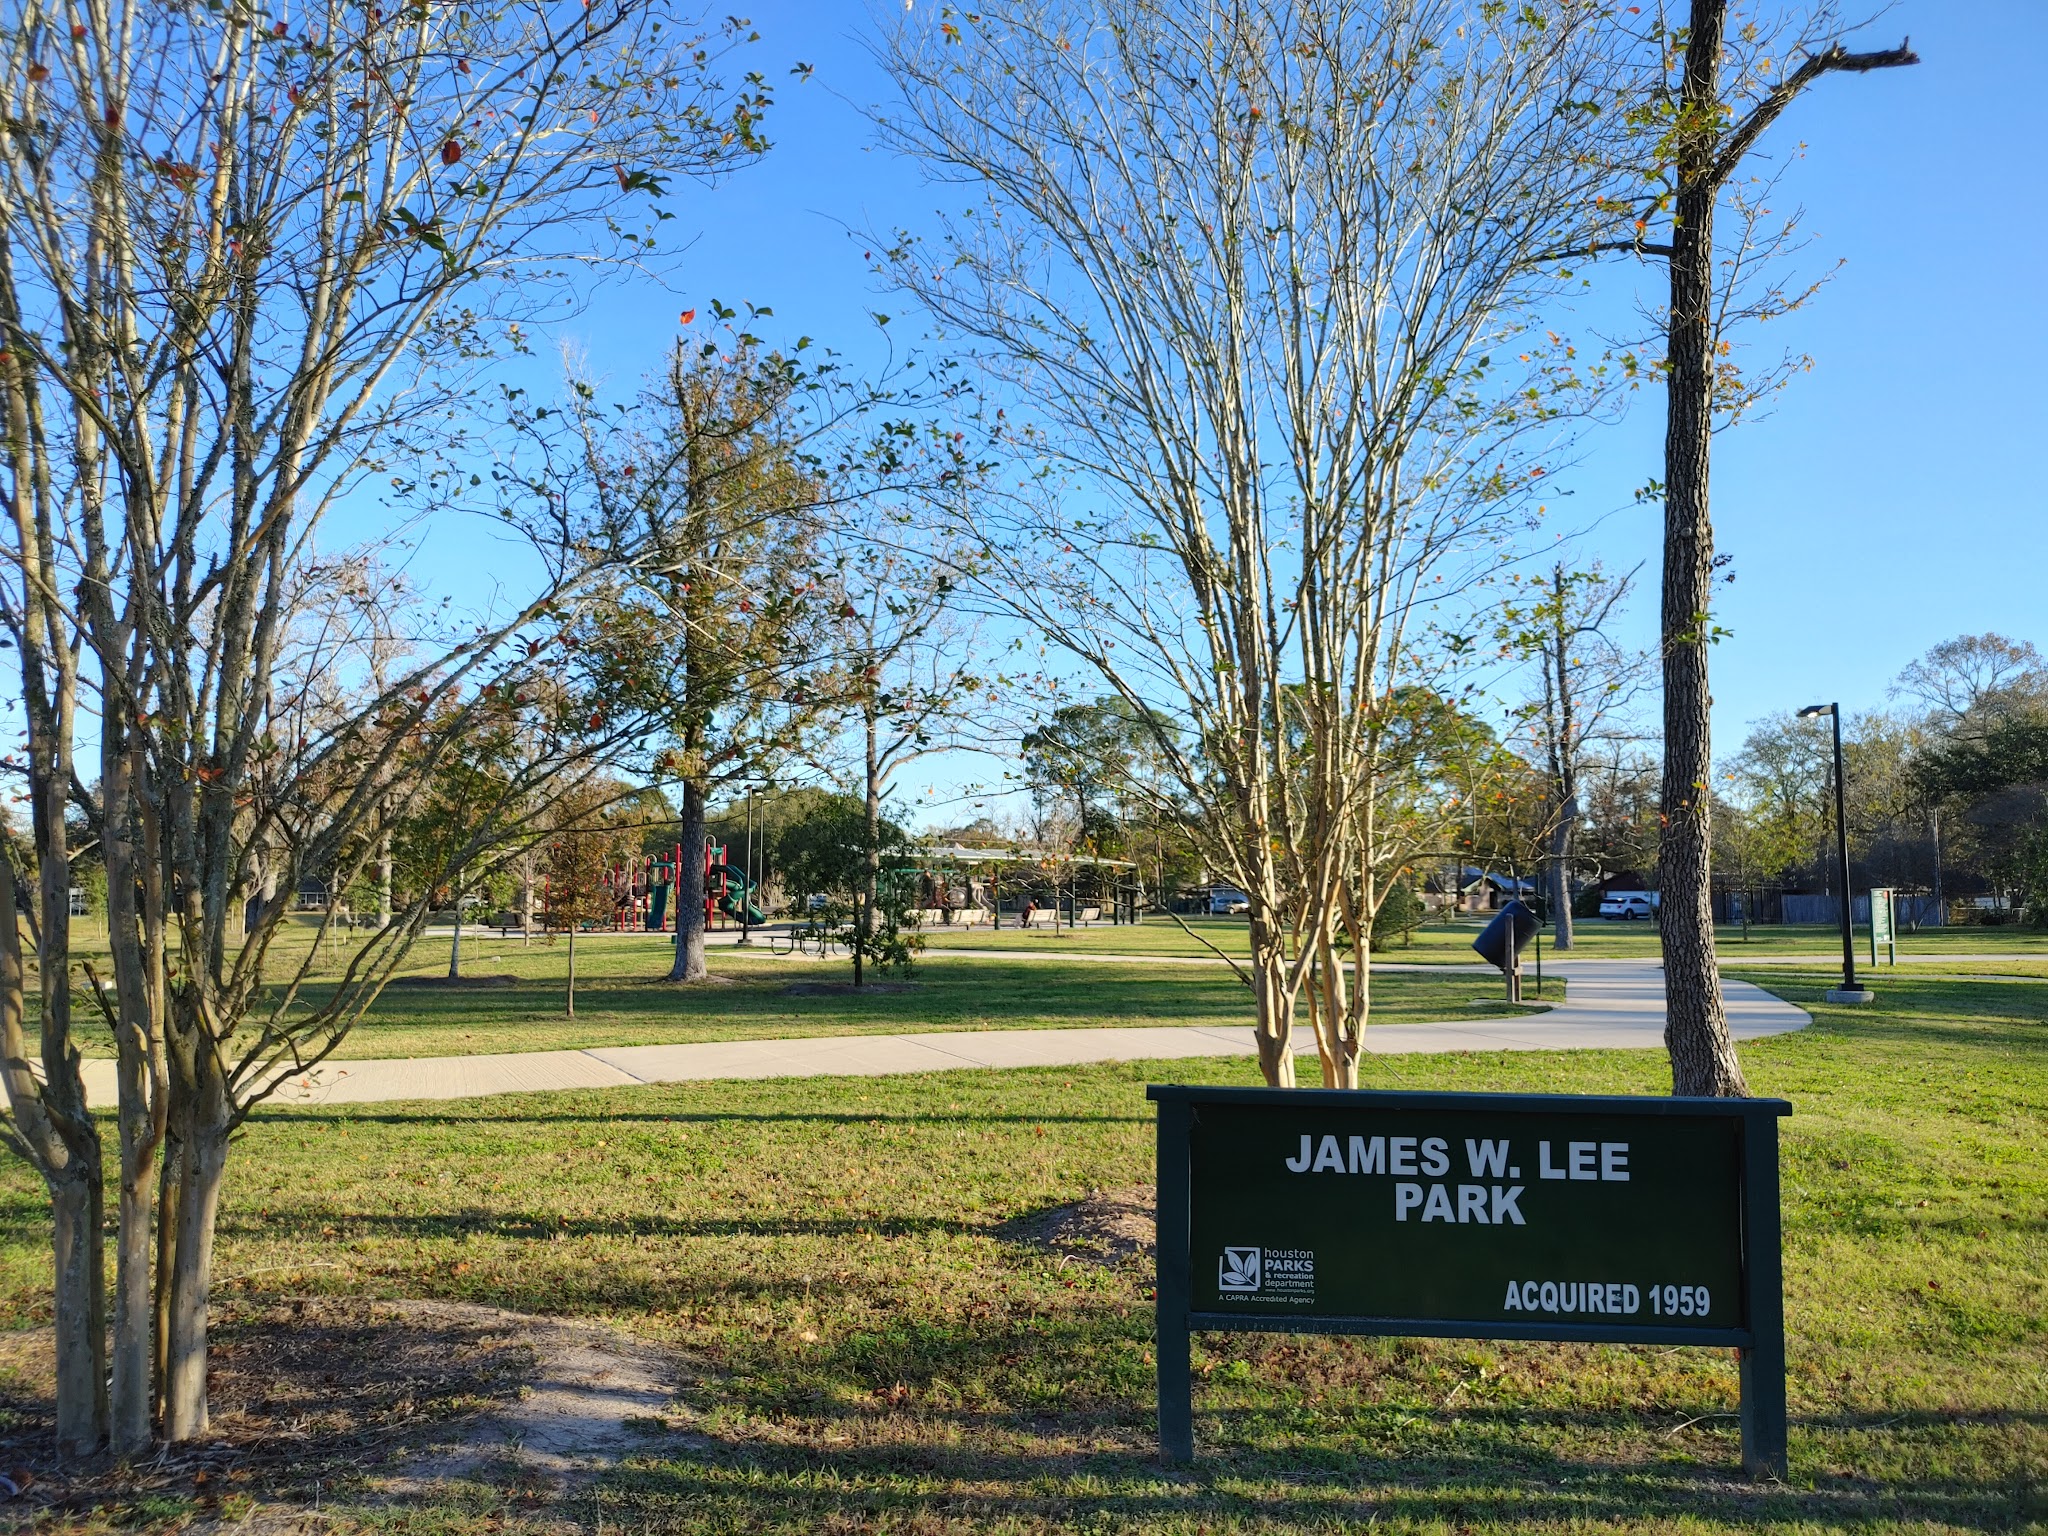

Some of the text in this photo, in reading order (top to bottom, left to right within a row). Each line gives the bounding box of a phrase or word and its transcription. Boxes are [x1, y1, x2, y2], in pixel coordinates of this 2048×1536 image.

[1286, 1134, 1630, 1182] JAMES W. LEE
[1395, 1182, 1526, 1225] PARK
[1264, 1247, 1314, 1259] houston
[1264, 1259, 1314, 1272] PARKS
[1273, 1272, 1314, 1280] recreation
[1264, 1279, 1314, 1288] department
[1251, 1295, 1288, 1303] Accredited
[1289, 1296, 1315, 1305] Agency
[1504, 1280, 1711, 1316] ACQUIRED 1959
